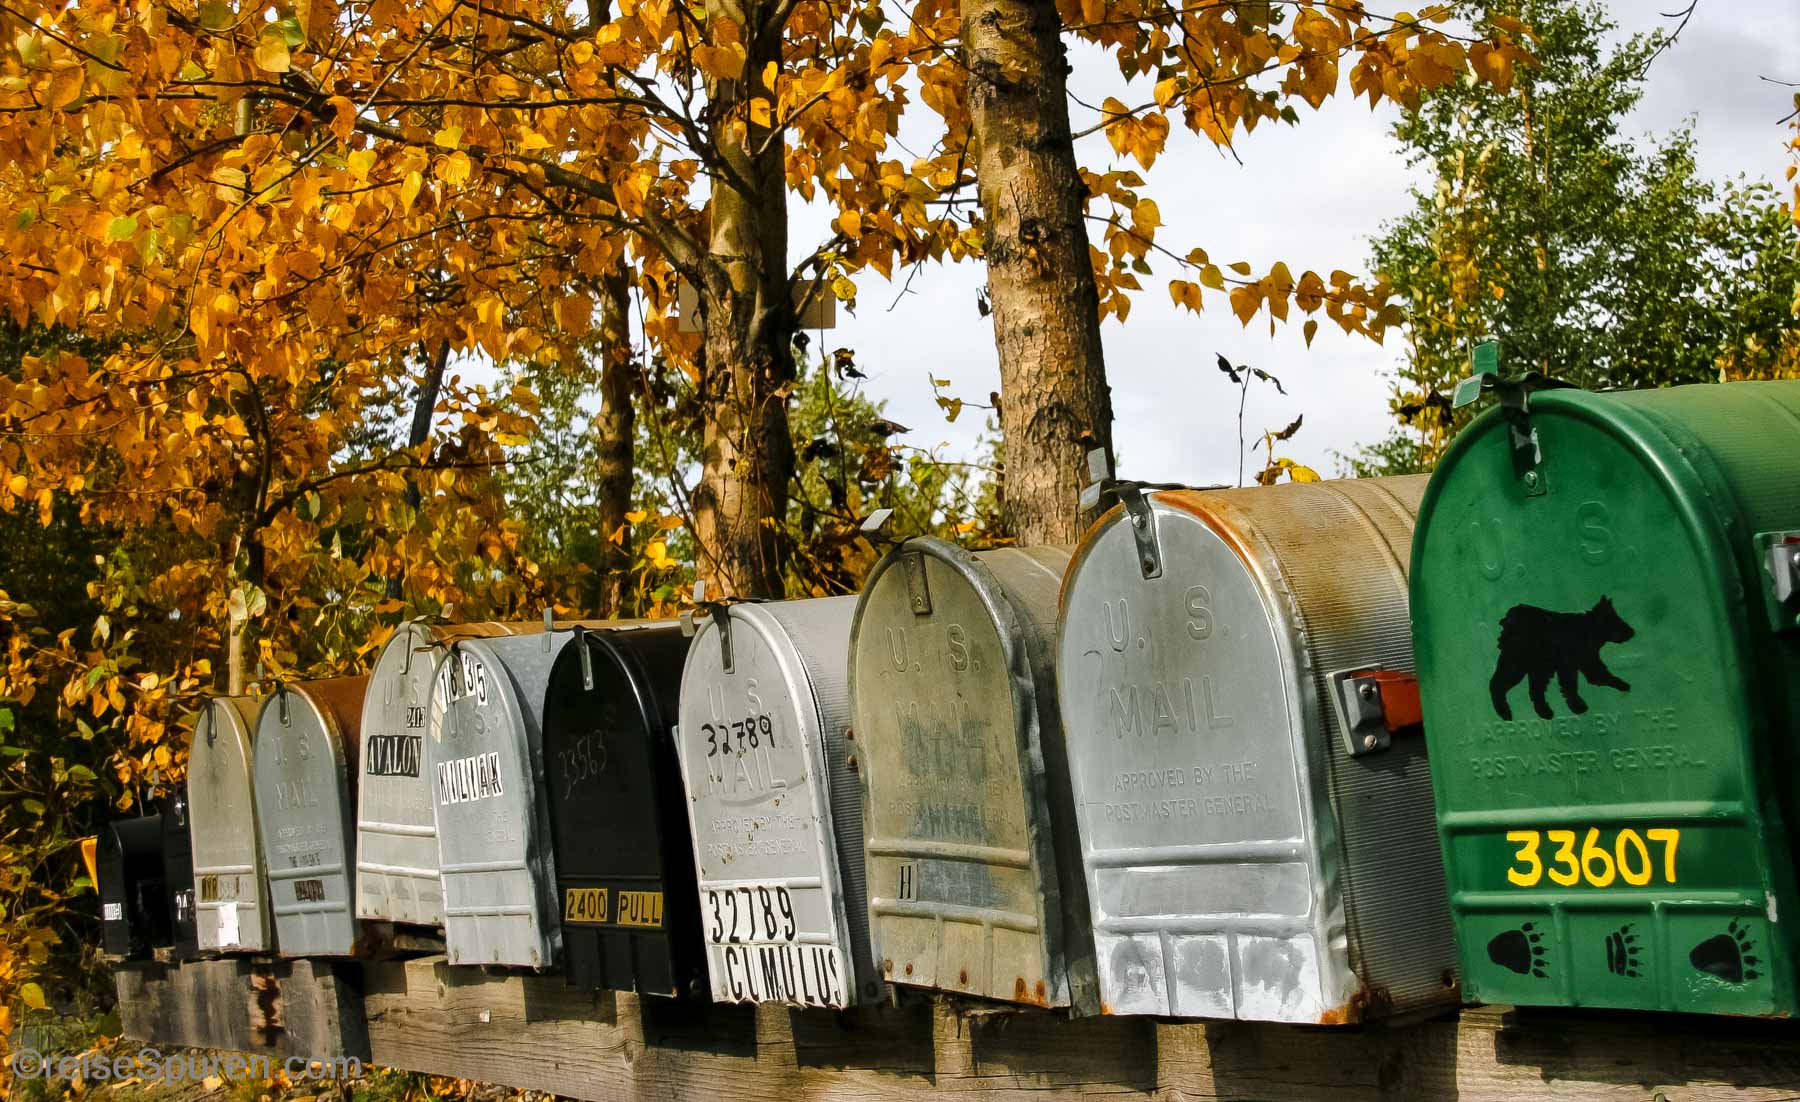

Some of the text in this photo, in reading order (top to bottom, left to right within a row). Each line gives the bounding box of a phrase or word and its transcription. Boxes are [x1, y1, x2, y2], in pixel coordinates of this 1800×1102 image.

[1103, 598, 1146, 653] U.
[1109, 676, 1234, 739] MAIL
[1482, 706, 1680, 744] APPROVED BY THE
[368, 736, 422, 775] AVALON
[702, 715, 777, 758] 32789
[1113, 762, 1256, 793] APPROVED BY THE
[1471, 745, 1708, 781] POSTMASTER GENERAL
[1105, 796, 1276, 824] POSTMASTER GENERAL
[1507, 826, 1680, 887] 33607
[566, 889, 662, 925] 2400 PULL
[709, 885, 796, 943] 32789
[726, 946, 843, 1001] CUMULUS
